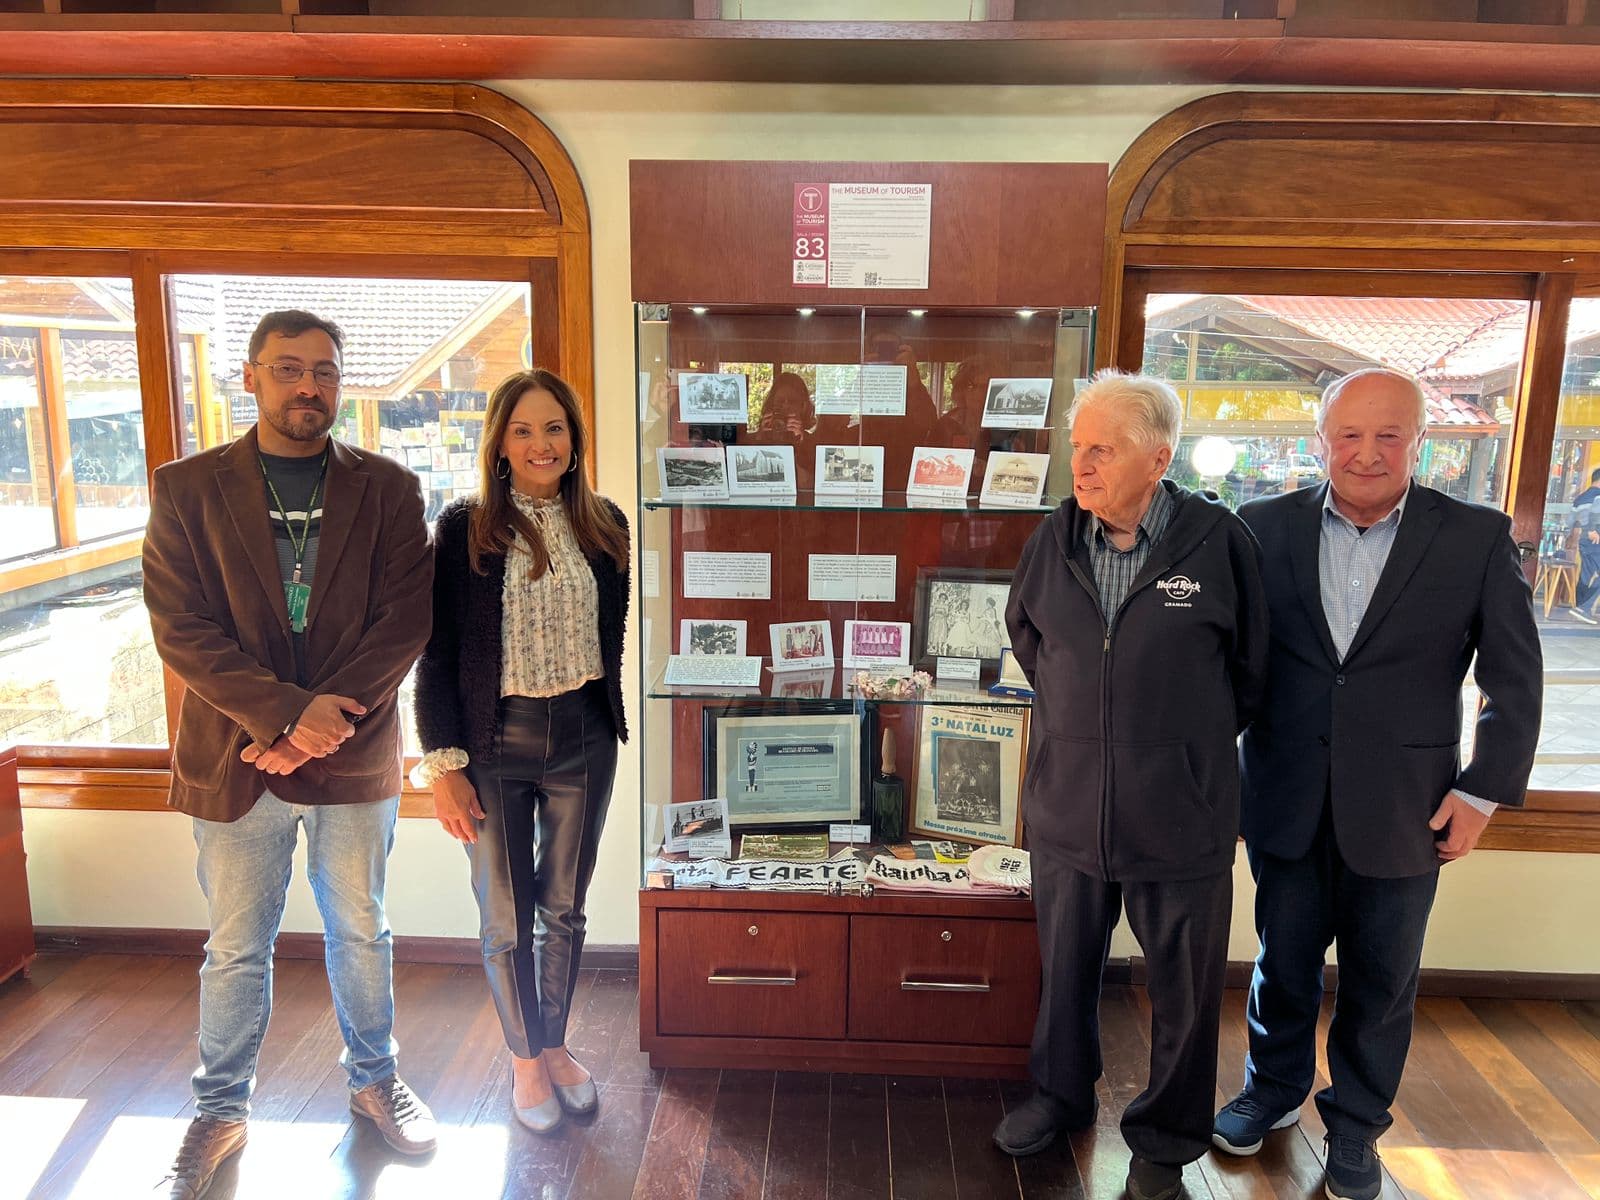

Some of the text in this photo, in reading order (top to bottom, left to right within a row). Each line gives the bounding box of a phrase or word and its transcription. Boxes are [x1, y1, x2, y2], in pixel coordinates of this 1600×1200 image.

[795, 237, 825, 258] 83
[1156, 580, 1201, 593] Hard Rock
[946, 719, 988, 734] NATAL
[990, 725, 1015, 738] LUZ
[726, 864, 857, 881] FEARTE
